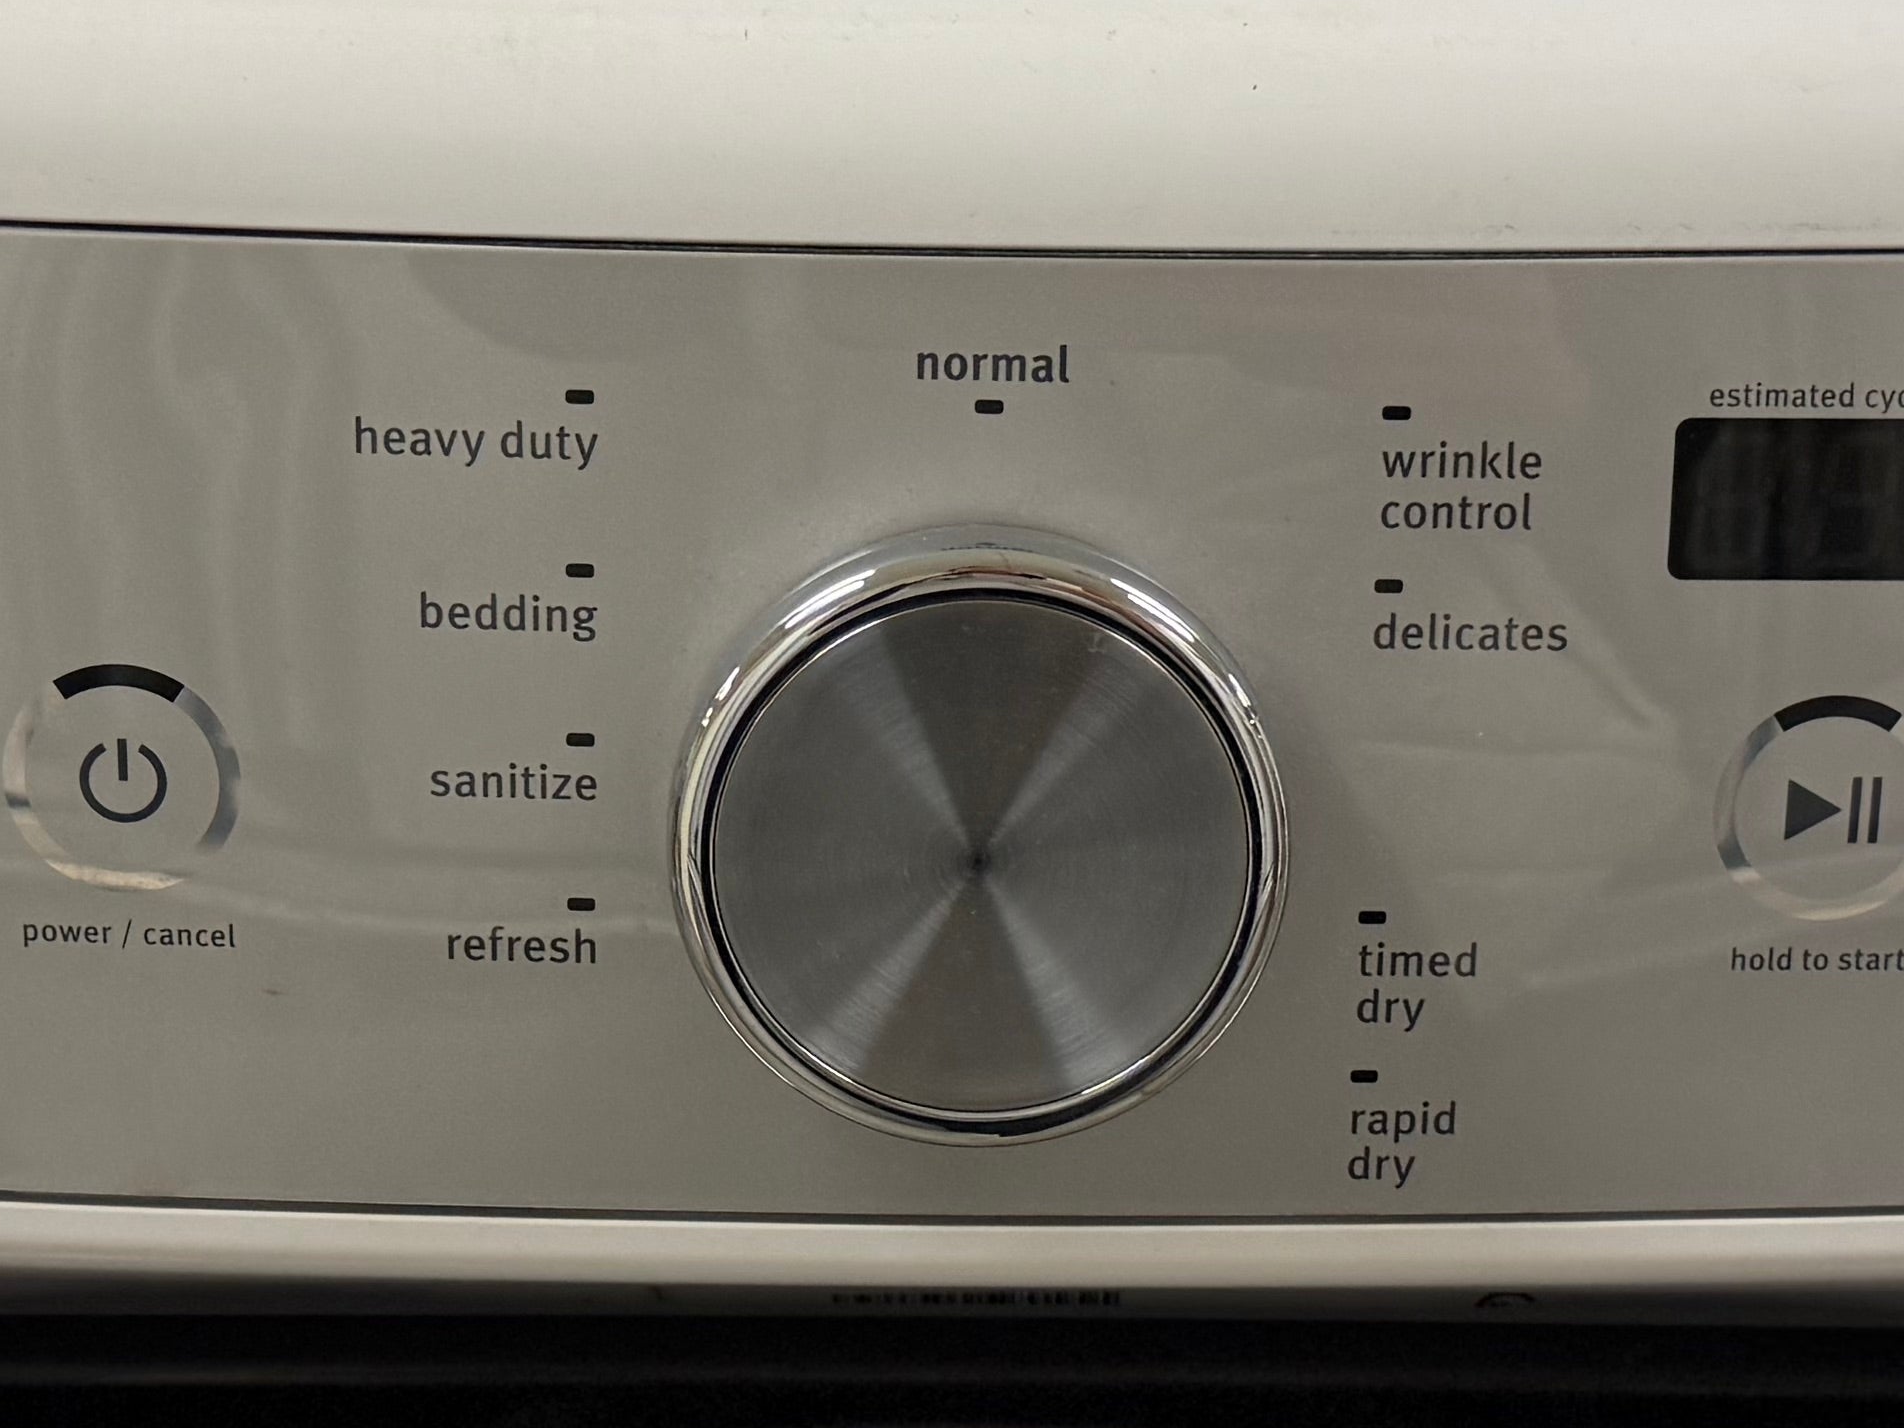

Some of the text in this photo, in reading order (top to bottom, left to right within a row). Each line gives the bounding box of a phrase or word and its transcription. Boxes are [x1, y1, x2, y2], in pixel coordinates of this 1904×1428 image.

[918, 345, 1069, 383] normal
[1710, 382, 1854, 408] estimated
[356, 416, 598, 470] heavy duty
[1383, 441, 1541, 479] wrinkle
[1381, 493, 1531, 530] control
[421, 591, 597, 642] bedding
[1374, 612, 1567, 651] delicates
[431, 763, 597, 800] sanitize
[22, 920, 112, 953] power
[144, 924, 235, 947] cancel
[448, 926, 596, 964] refresh
[1359, 942, 1476, 977] timed
[1732, 947, 1904, 971] hold to start
[1357, 988, 1424, 1032] dry
[1352, 1101, 1455, 1143] rapid
[1348, 1146, 1415, 1189] dry
